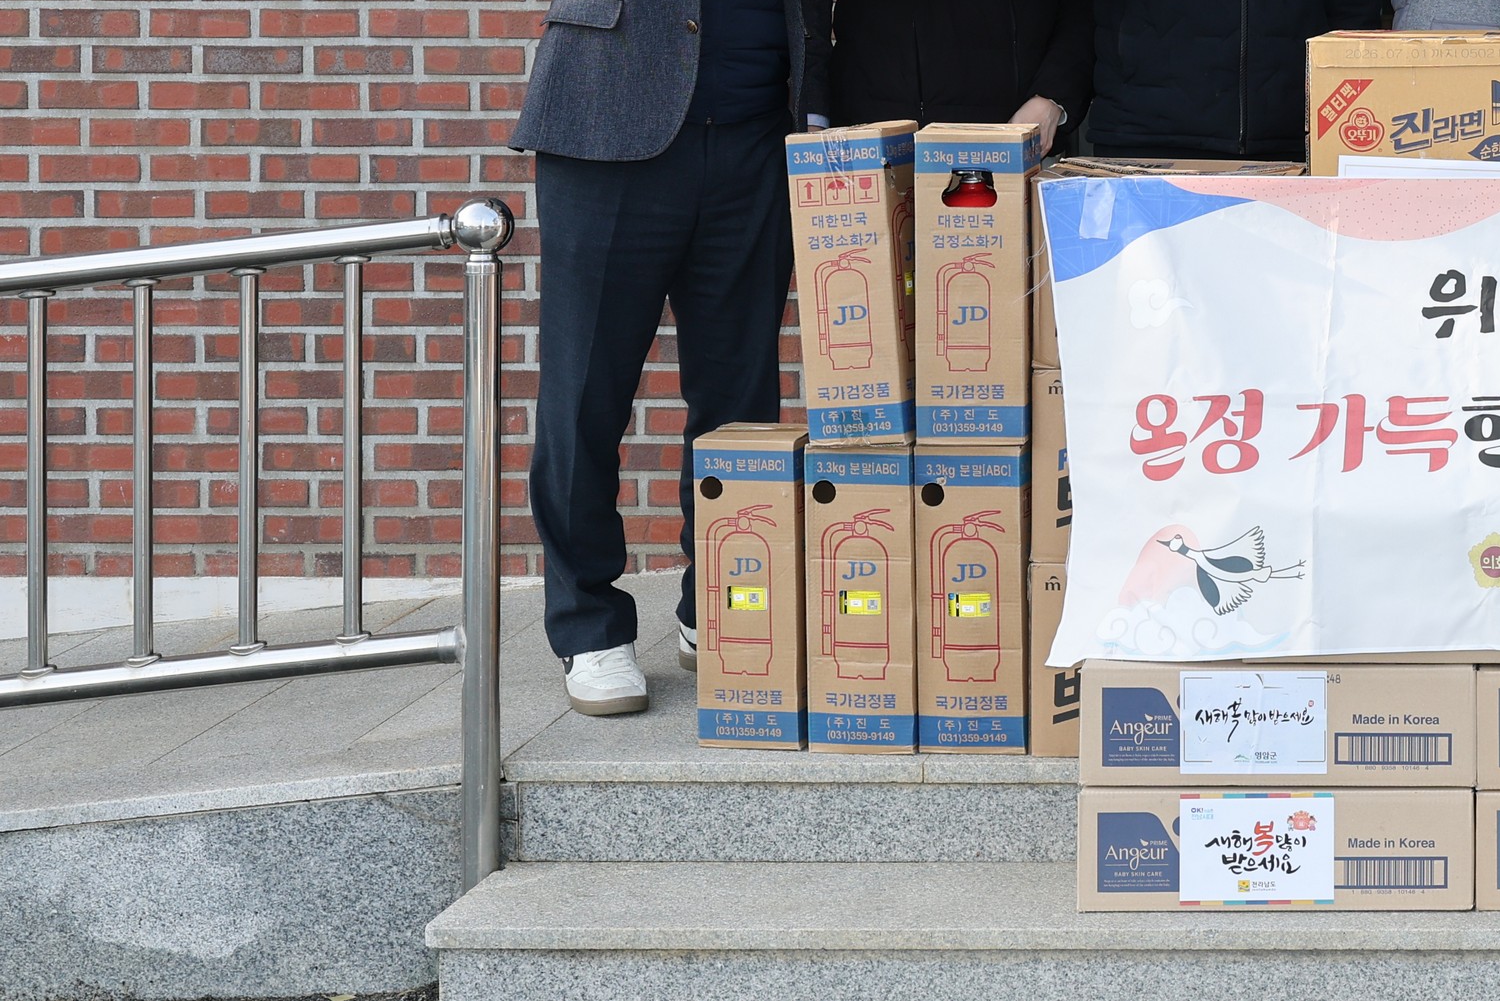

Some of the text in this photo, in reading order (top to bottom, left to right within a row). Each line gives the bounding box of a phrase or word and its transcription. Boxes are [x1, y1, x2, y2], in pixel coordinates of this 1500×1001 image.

[1321, 82, 1358, 122] 멀티팩
[1347, 129, 1378, 141] 오뚜기
[1389, 107, 1486, 154] 진라면
[793, 151, 824, 166] 3.3kg
[923, 150, 954, 164] 3.3kg
[811, 212, 868, 229] 대한민국
[937, 214, 995, 229] 대한민국
[807, 232, 878, 250] 검정소화기
[932, 234, 1004, 249] 검정소화기
[1421, 268, 1498, 339] 위
[832, 304, 867, 326] JD
[951, 305, 989, 326] JD
[817, 382, 890, 401] 국가검정품
[930, 384, 1005, 400] 국가검정품
[822, 421, 892, 436] (031)359-9149
[932, 423, 1004, 435] (031)359-9149
[1129, 388, 1265, 482] 온정
[703, 458, 733, 472] 3.3kg
[728, 557, 762, 576] JD
[841, 561, 877, 580] JD
[951, 563, 987, 583] JD
[714, 688, 783, 706] 국가검정품
[825, 692, 897, 710] 국가검정품
[935, 694, 1008, 711] 국가검정품
[1352, 714, 1440, 725] Made in Korea
[715, 726, 782, 738] (031)359-9149
[826, 730, 896, 743] (031)359-9149
[937, 731, 1008, 744] (031)359-9149
[1109, 719, 1173, 745] Angeur
[1254, 751, 1277, 761] 영암군
[1104, 845, 1168, 871] Angeur
[1221, 852, 1301, 875] 받으세요
[1251, 880, 1277, 888] 전라남도
